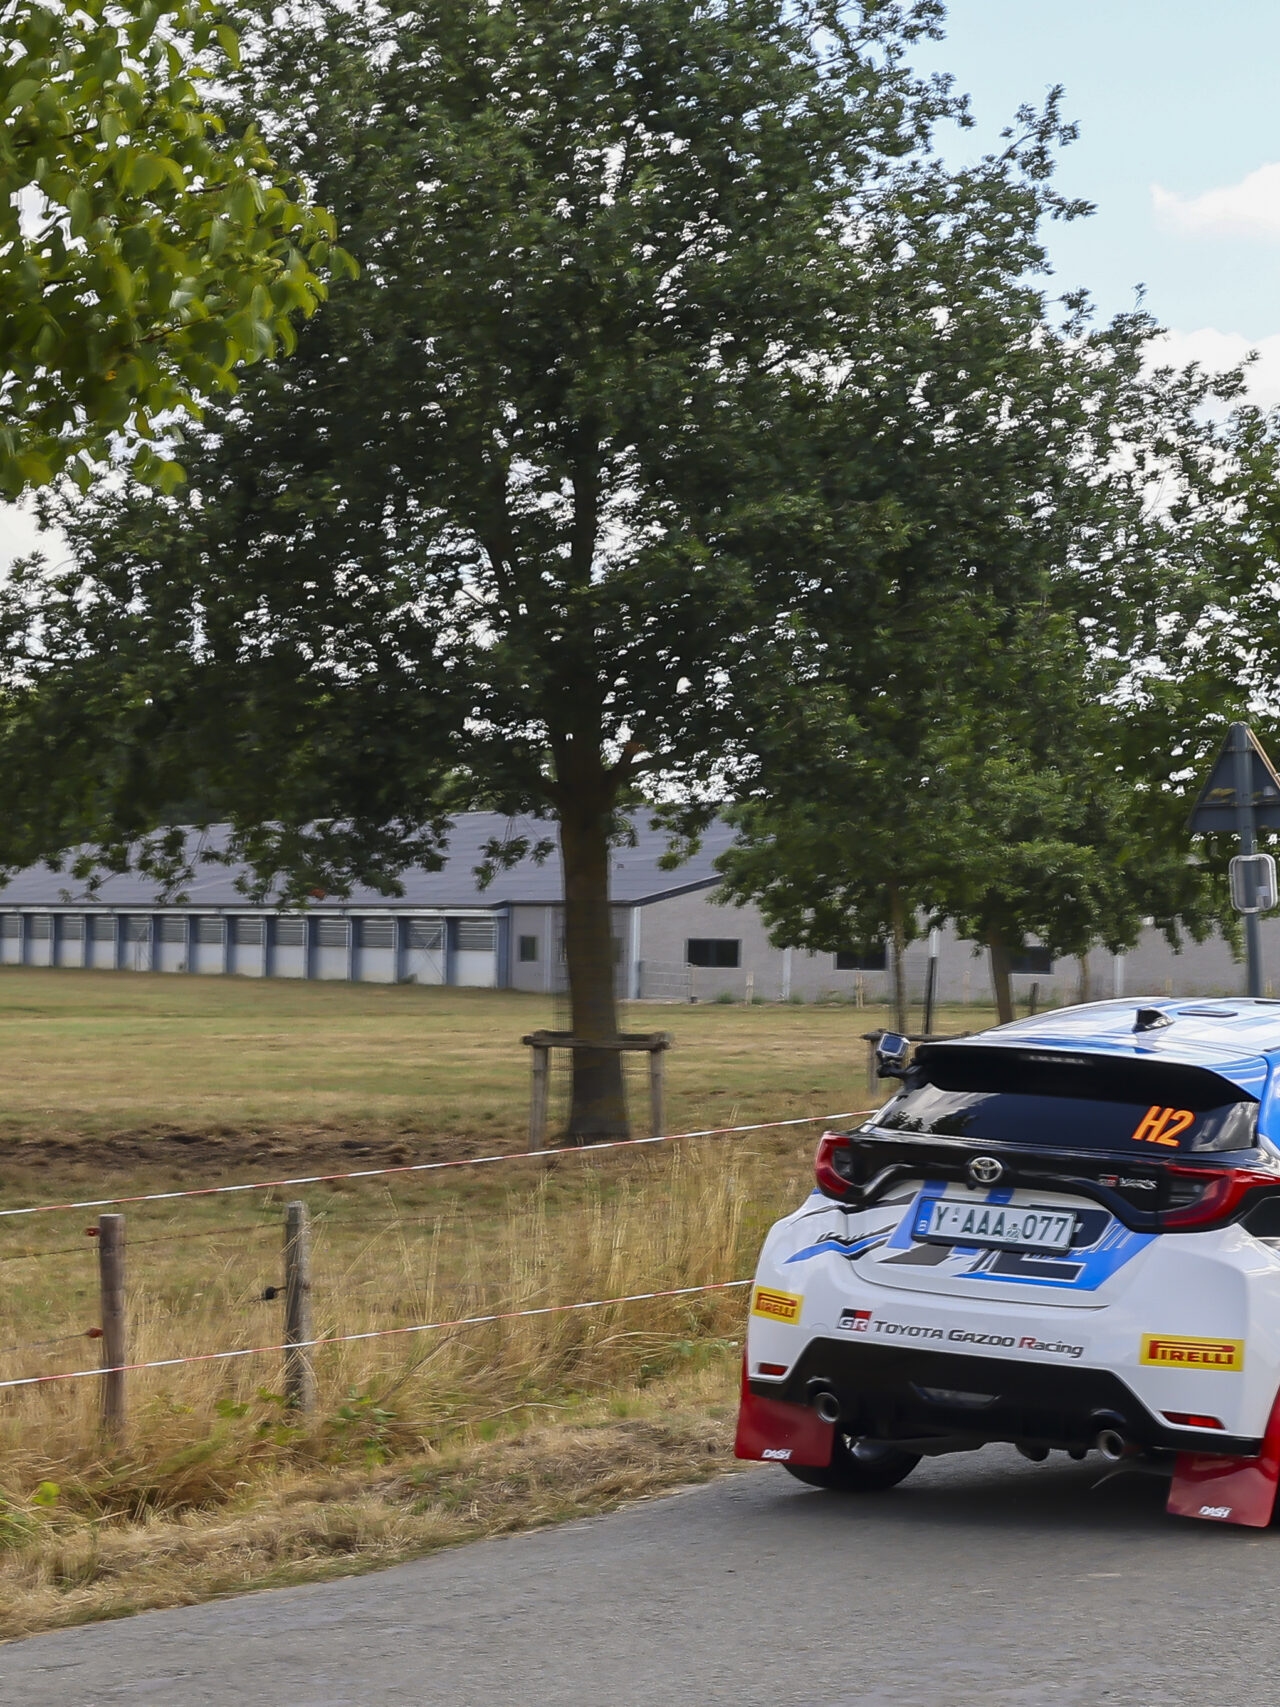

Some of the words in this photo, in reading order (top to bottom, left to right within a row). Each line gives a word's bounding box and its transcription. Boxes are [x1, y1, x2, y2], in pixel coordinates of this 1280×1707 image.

[1131, 1105, 1195, 1147] H2
[756, 1292, 797, 1318] PIRELLI
[873, 1320, 943, 1340] TOYOTA
[948, 1329, 1015, 1348] GAZOO
[1018, 1336, 1084, 1359] Racing
[1148, 1340, 1235, 1365] PIRELLI
